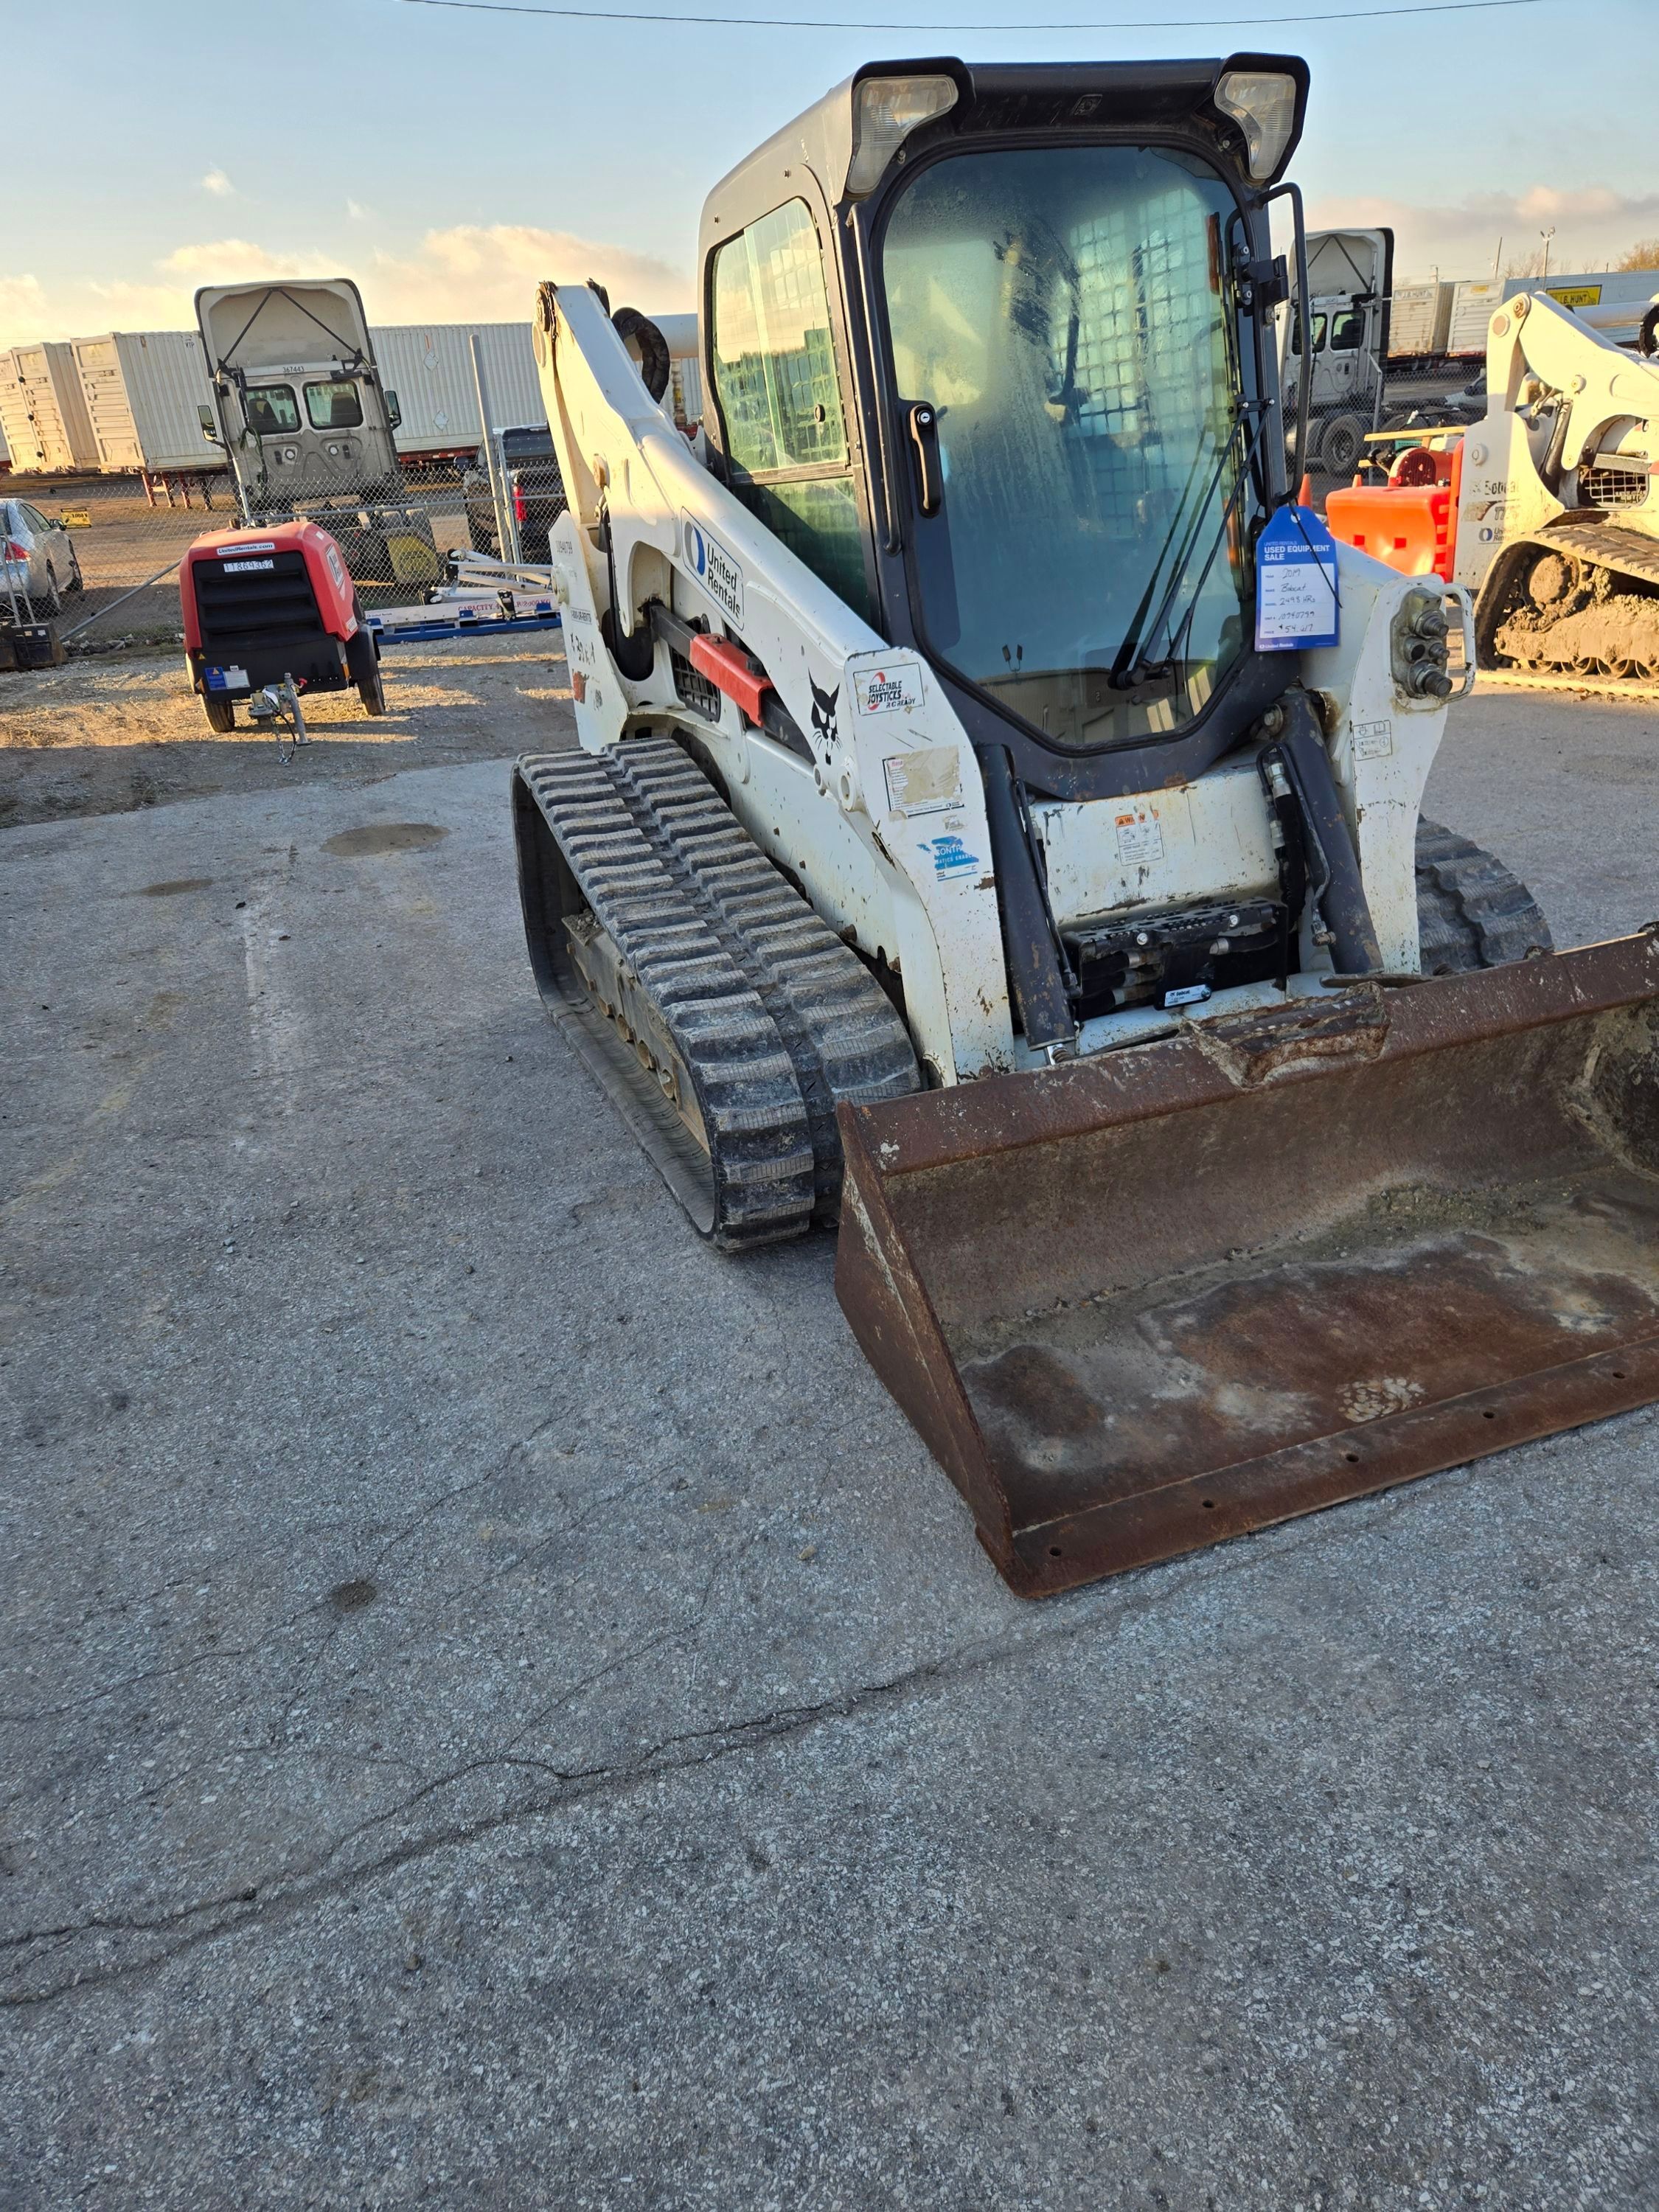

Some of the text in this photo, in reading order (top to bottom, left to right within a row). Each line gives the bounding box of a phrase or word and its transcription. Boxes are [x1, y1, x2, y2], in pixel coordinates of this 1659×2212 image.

[1571, 293, 1587, 303] HUNT
[1264, 546, 1286, 554] USED
[707, 542, 737, 592] United
[707, 566, 740, 619] Rentals
[457, 603, 493, 612] CAPACITY
[869, 681, 902, 694] SELECTABLE
[867, 689, 902, 705] JOYSTICKS
